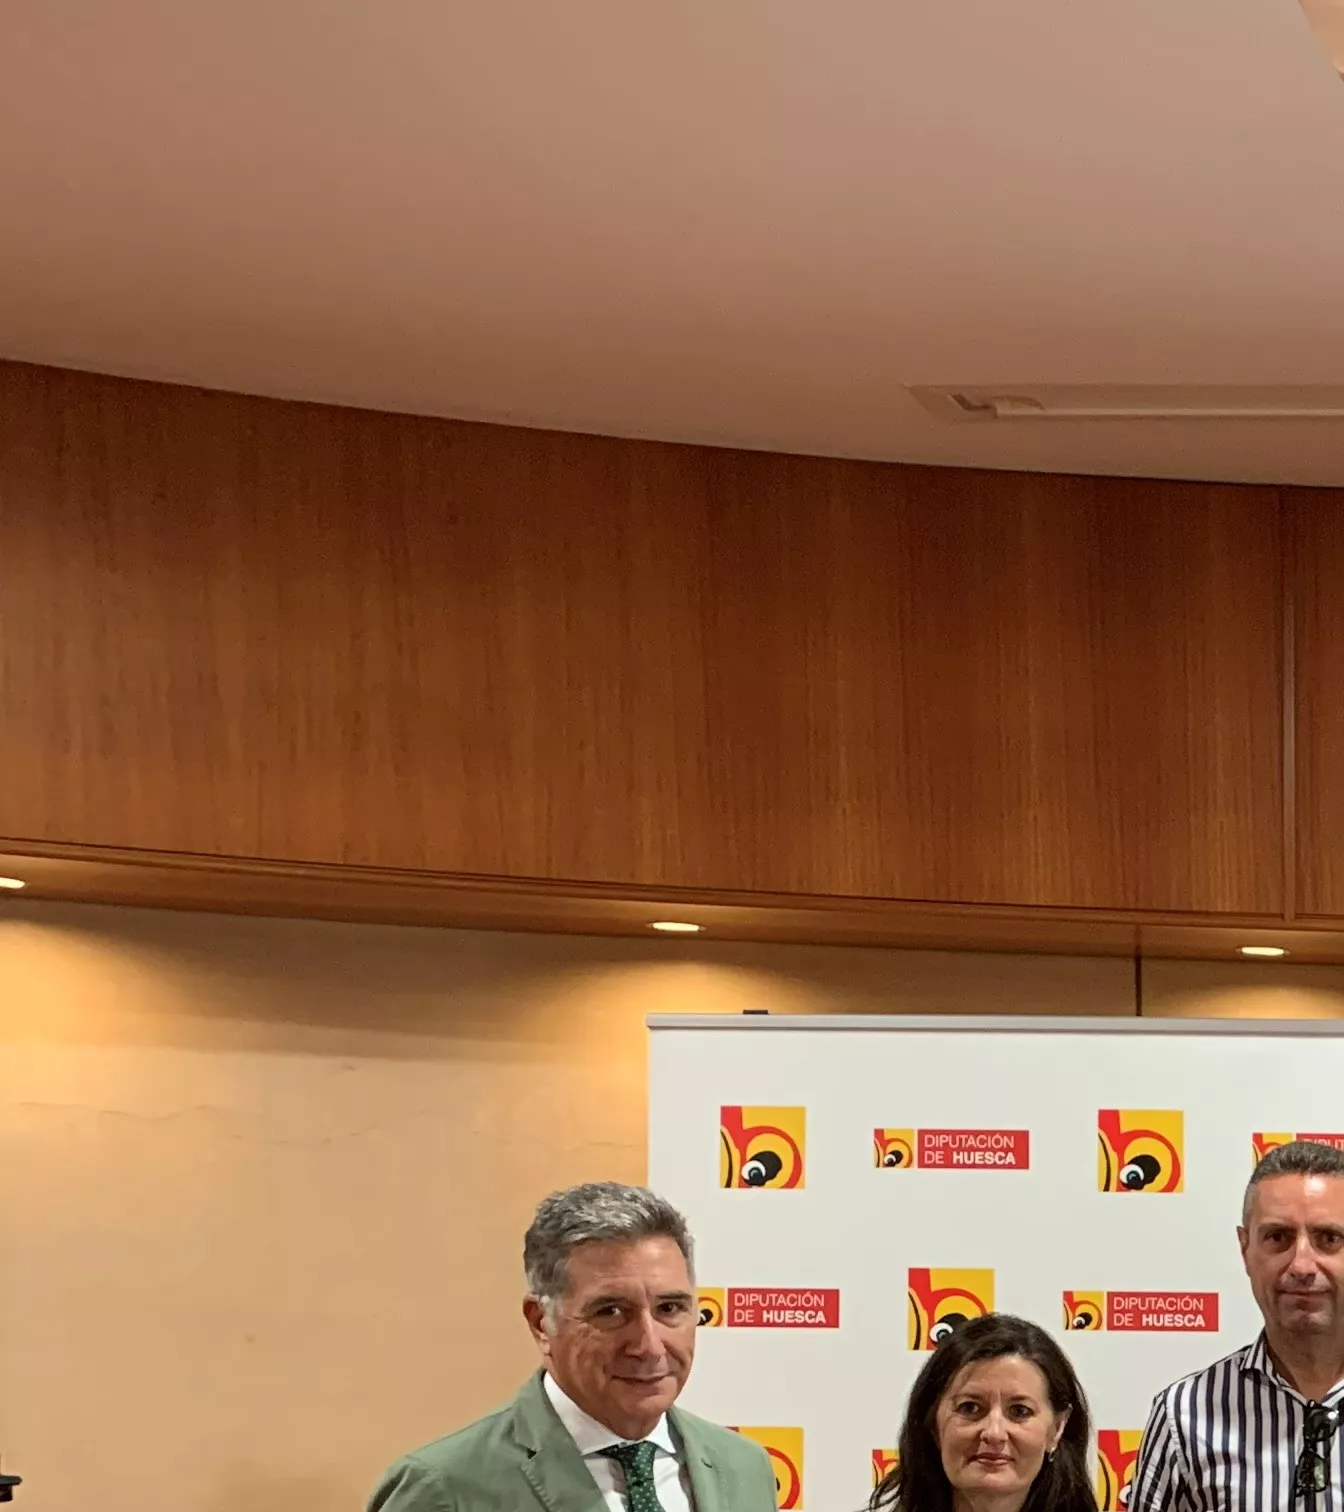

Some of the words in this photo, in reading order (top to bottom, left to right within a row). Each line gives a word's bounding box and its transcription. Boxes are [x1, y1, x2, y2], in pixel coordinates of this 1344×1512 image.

[924, 1133, 1014, 1148] DIPUTACIÓN
[924, 1151, 944, 1164] DE
[952, 1151, 1016, 1165] HUESCA
[734, 1291, 824, 1307] DIPUTACIÓN
[1114, 1296, 1204, 1312] DIPUTACIÓN
[734, 1310, 754, 1323] DE
[762, 1310, 826, 1324] HUESCA
[1114, 1314, 1134, 1327] DE
[1142, 1314, 1205, 1328] HUESCA
